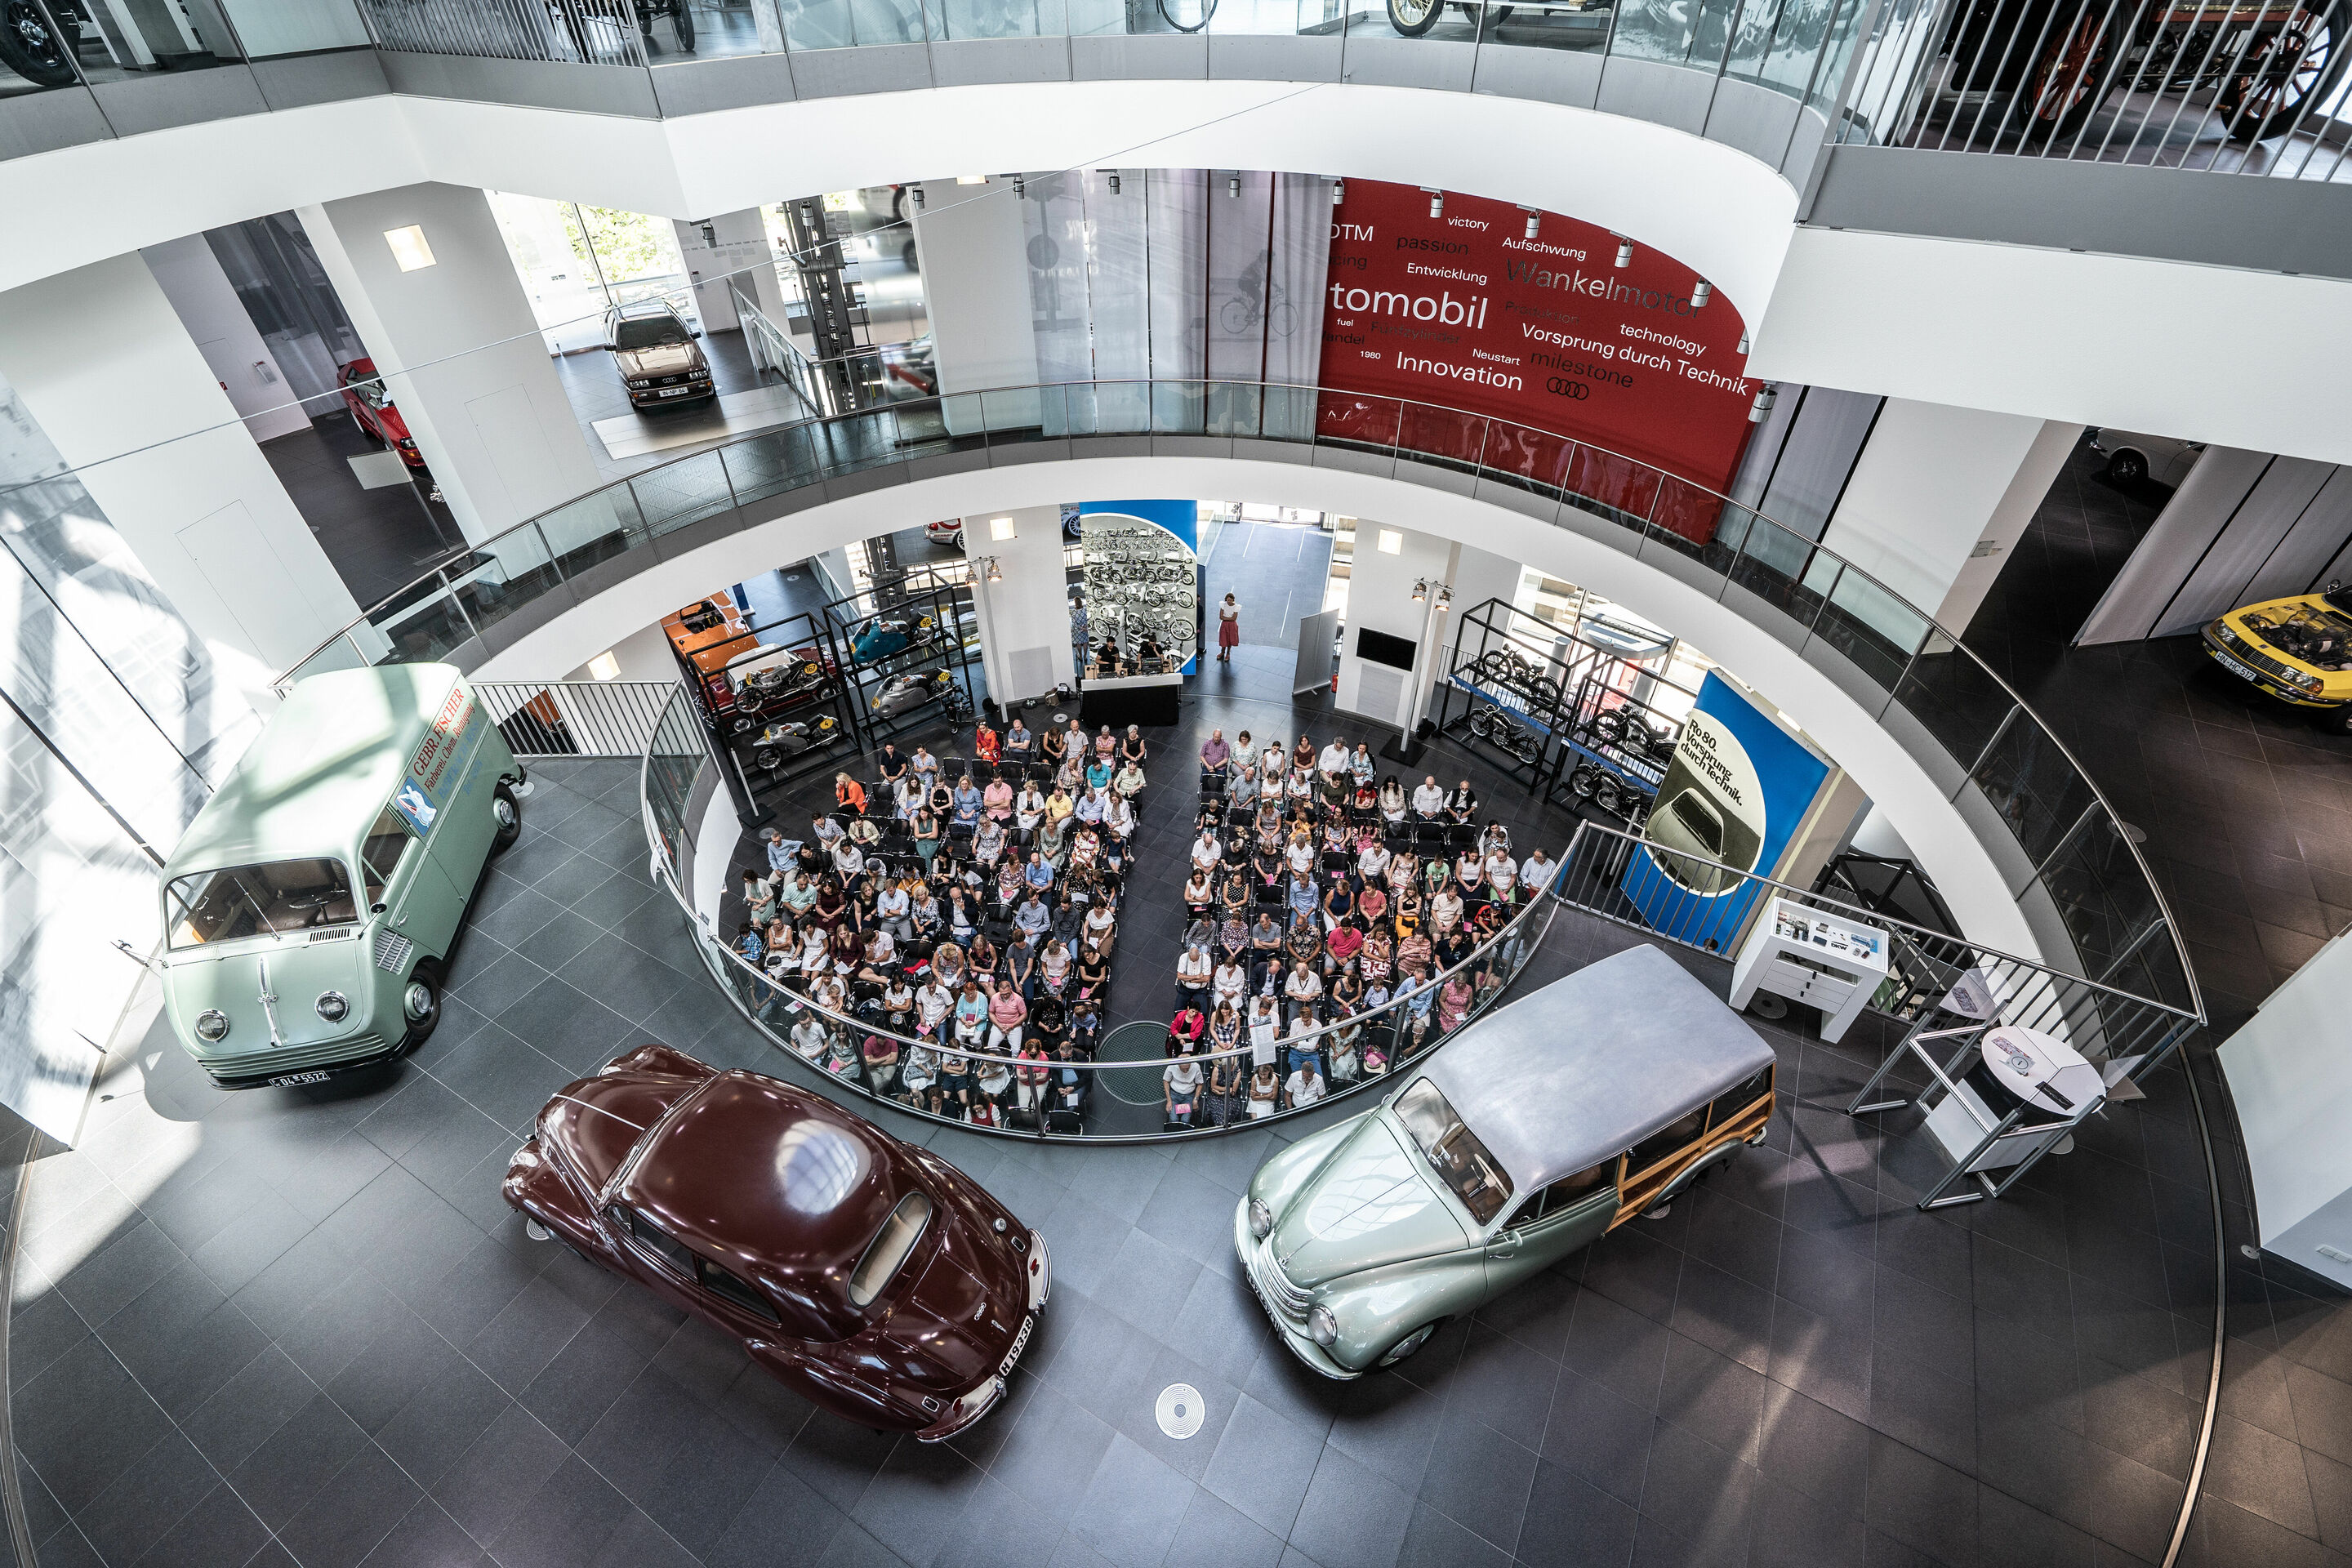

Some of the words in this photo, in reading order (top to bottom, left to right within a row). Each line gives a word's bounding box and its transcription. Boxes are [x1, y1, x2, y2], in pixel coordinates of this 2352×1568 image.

[1447, 216, 1490, 232] victory
[1396, 236, 1469, 256] passion
[1502, 237, 1587, 261] Aufschwung
[1406, 262, 1488, 286] Entwicklung
[1336, 318, 1354, 327] fuel
[1619, 323, 1707, 357] technology
[1360, 350, 1381, 359] 1980
[1472, 348, 1521, 366] Neustart
[1521, 323, 1615, 360] Vorsprung
[1619, 345, 1672, 372] durch
[1677, 359, 1750, 396] Technik
[1396, 351, 1522, 391] Innovation
[1530, 351, 1634, 388] milestone
[921, 618, 931, 627] 90
[805, 664, 816, 673] 167
[939, 672, 949, 681] 100
[2216, 652, 2240, 672] HN-HC
[2240, 666, 2256, 681] 517
[413, 737, 439, 777] GEBR.
[432, 688, 465, 741] FISCHER
[452, 702, 476, 739] Reinigung
[1688, 719, 1702, 737] Ro
[1686, 730, 1733, 782] Vorsprung
[1681, 742, 1707, 770] durch
[1705, 763, 1743, 806] Technik.
[1831, 942, 1847, 951] DKW
[301, 1071, 327, 1083] 5522
[1001, 1361, 1011, 1374] H
[1009, 1318, 1033, 1363] 19338
